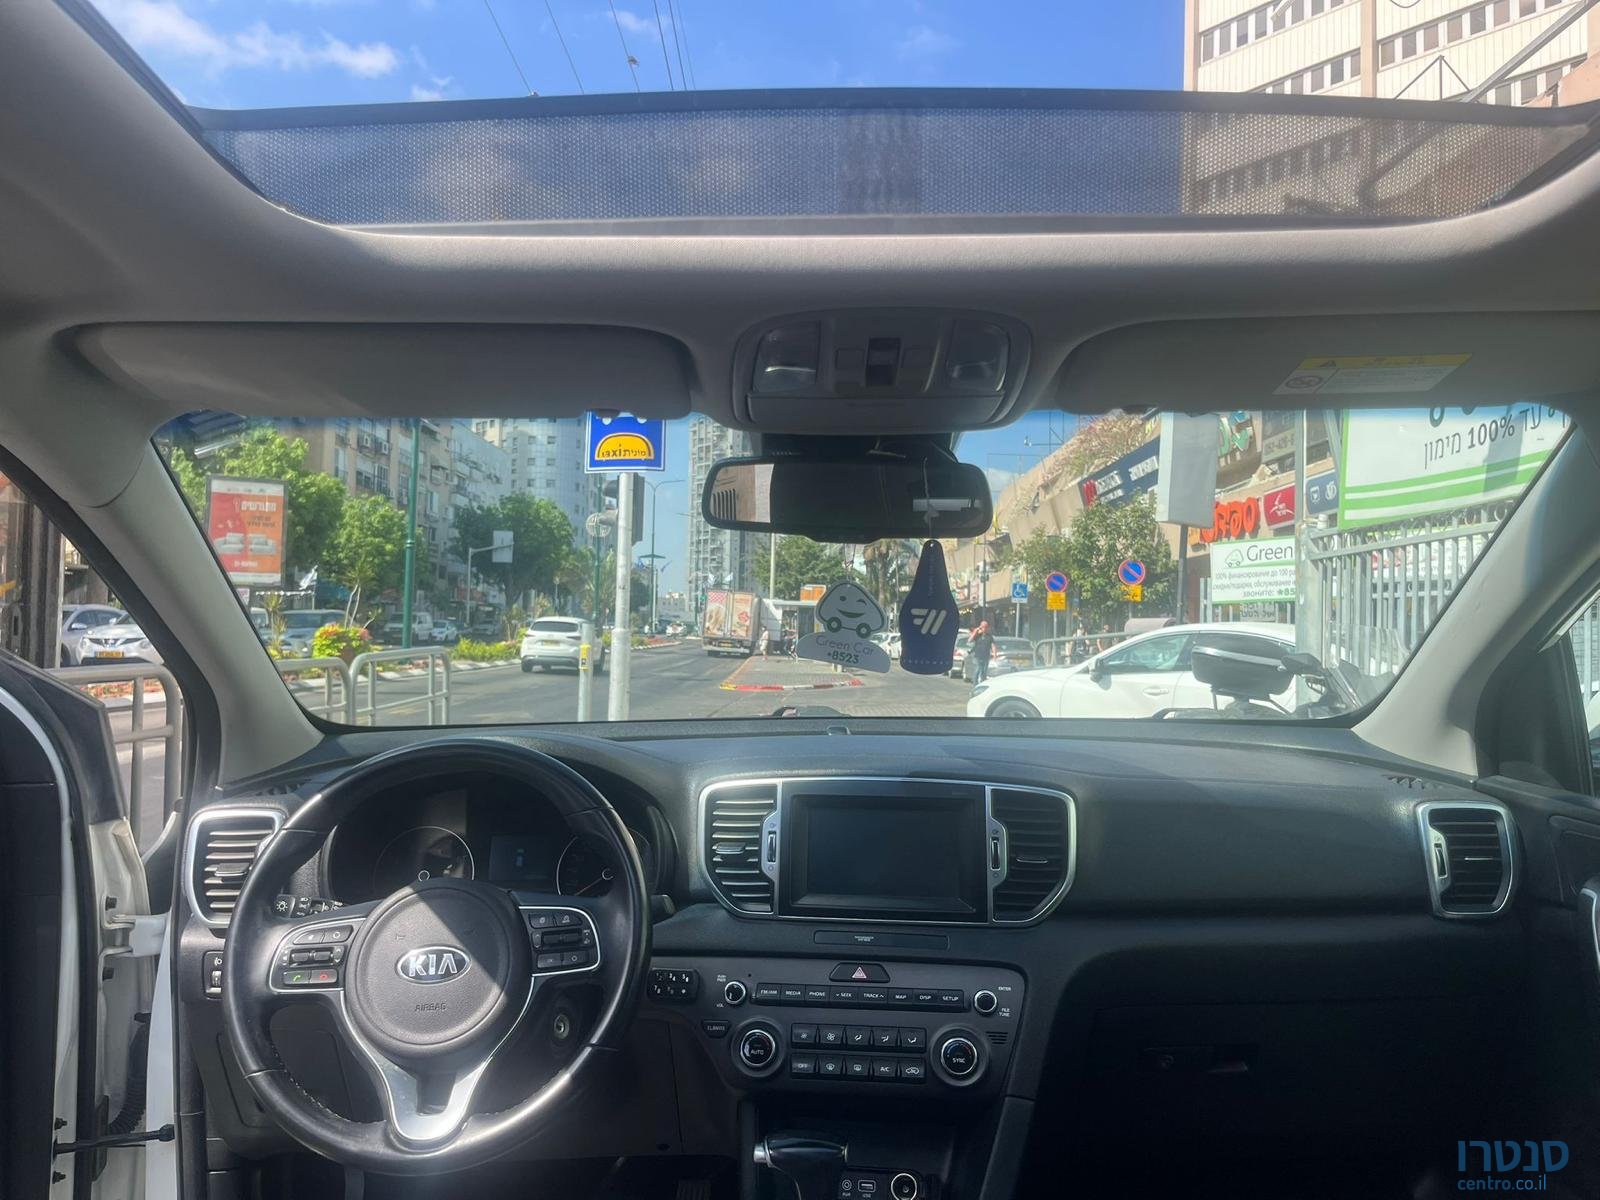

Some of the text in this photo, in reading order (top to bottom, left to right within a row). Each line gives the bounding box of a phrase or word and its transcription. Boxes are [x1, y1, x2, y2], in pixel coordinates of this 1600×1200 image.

[1468, 414, 1515, 449] 100%
[1424, 432, 1462, 470] מימון
[1246, 544, 1294, 562] Green
[815, 635, 875, 656] Green Car
[408, 953, 458, 977] KIA
[414, 1002, 447, 1011] AIRBAG
